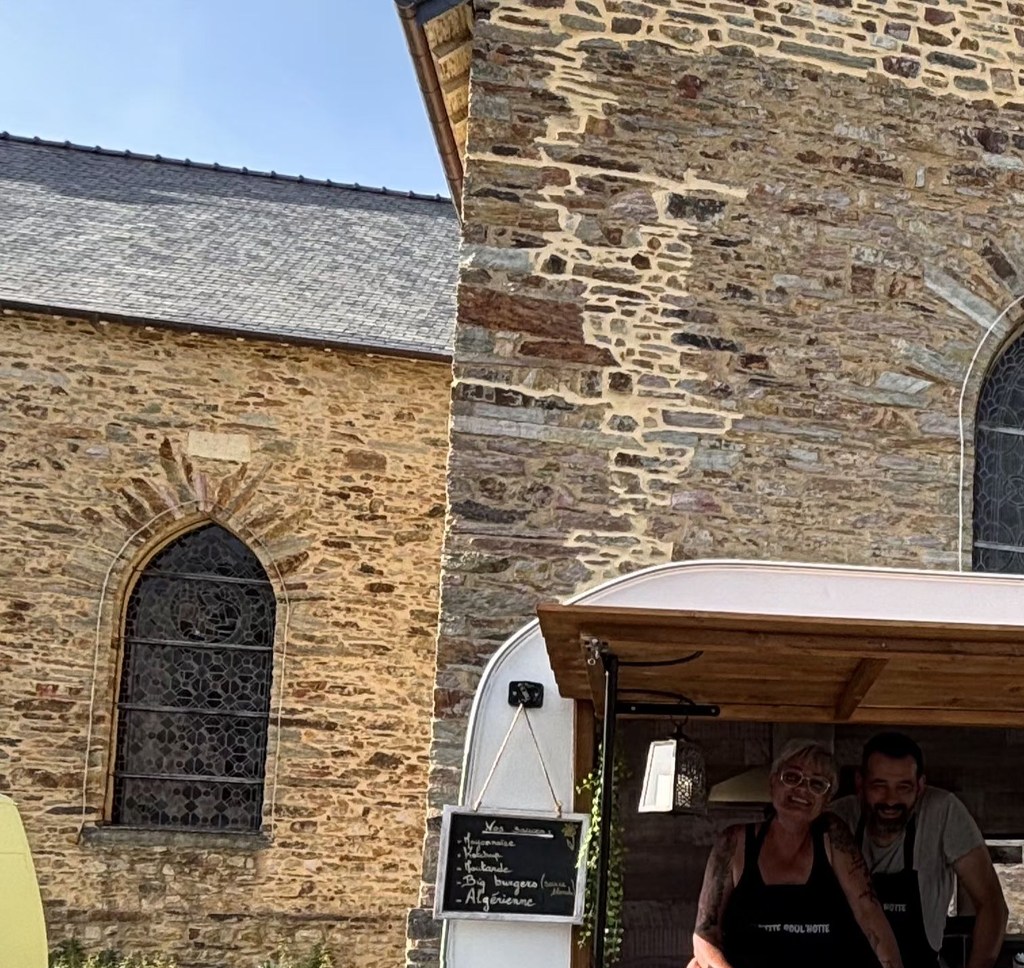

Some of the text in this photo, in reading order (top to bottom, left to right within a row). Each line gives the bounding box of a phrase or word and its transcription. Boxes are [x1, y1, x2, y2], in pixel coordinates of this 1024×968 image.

[460, 873, 487, 894] Big
[493, 874, 538, 895] burgers
[464, 886, 537, 912] Algérienne
